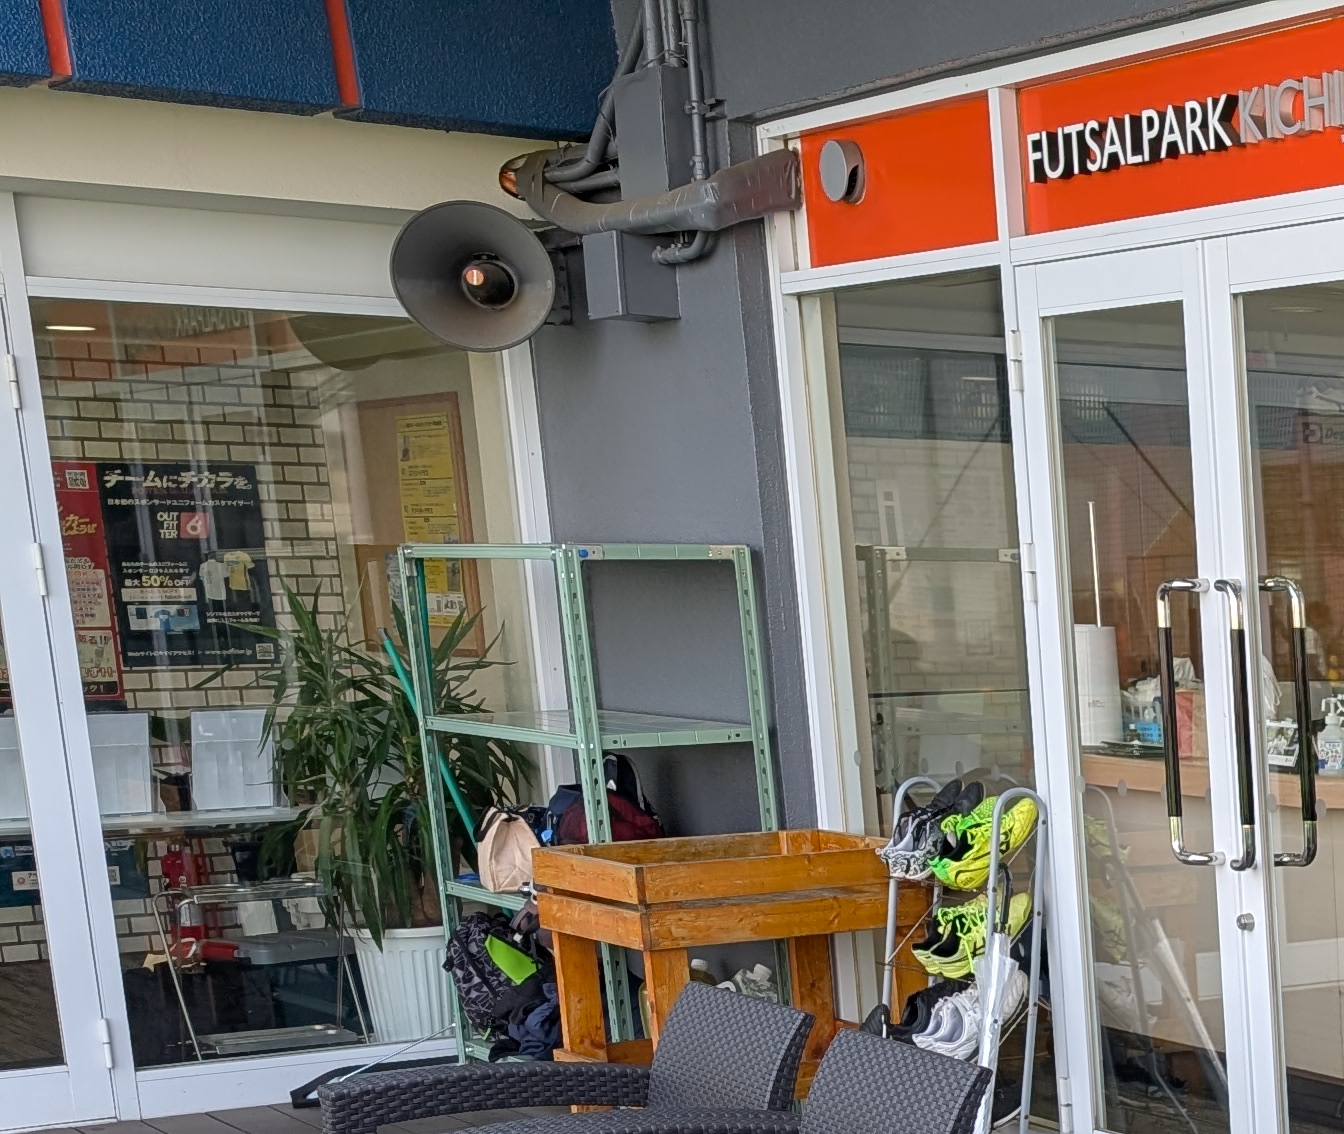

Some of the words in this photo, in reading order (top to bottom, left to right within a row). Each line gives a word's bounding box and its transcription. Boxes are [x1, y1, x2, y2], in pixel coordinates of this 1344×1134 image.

[1026, 93, 1232, 184] FUTSALPARK
[157, 511, 179, 521] OUT
[159, 529, 178, 539] TER
[141, 575, 173, 587] 50%
